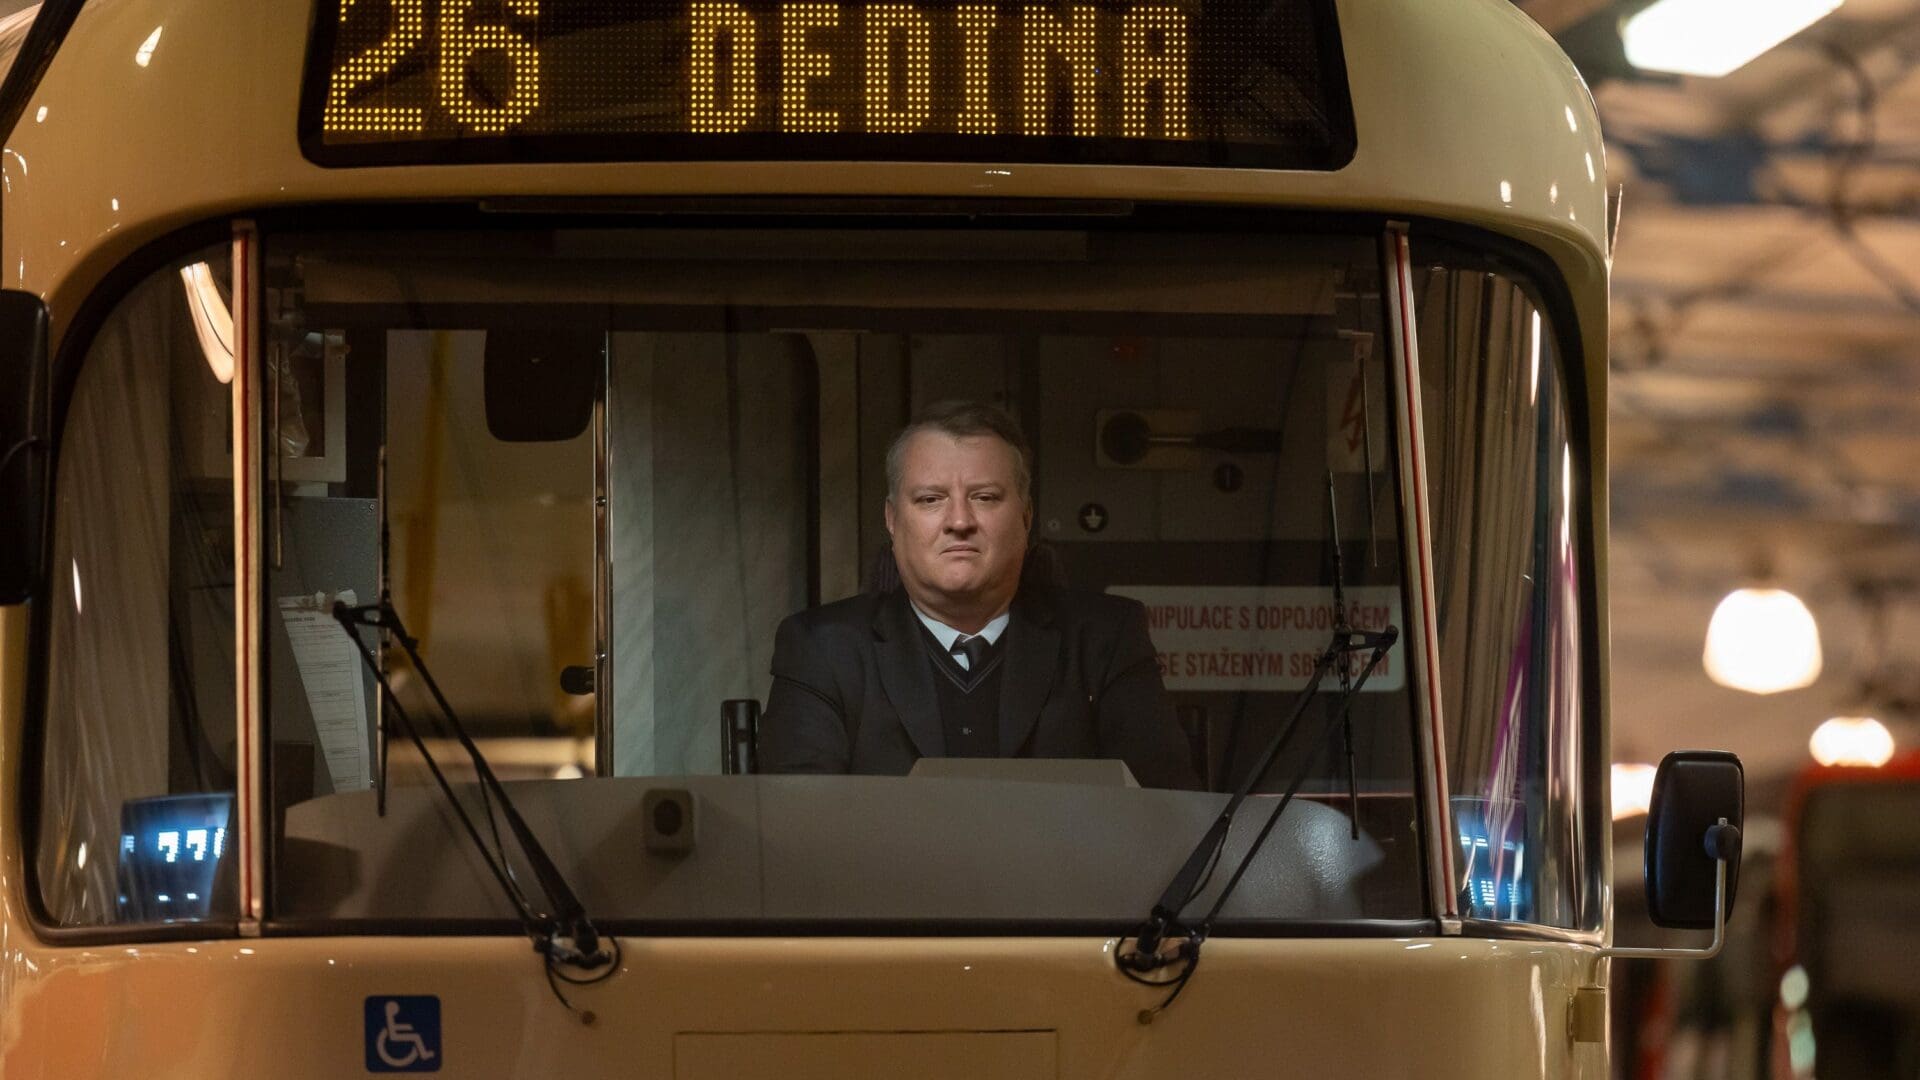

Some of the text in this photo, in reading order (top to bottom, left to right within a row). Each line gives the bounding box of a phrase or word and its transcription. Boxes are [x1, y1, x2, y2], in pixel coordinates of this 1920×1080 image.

[322, 0, 540, 132] 26
[1145, 602, 1391, 631] NIPULACE S ODPOJOVČEM
[1186, 648, 1283, 677] STAŽENÝM
